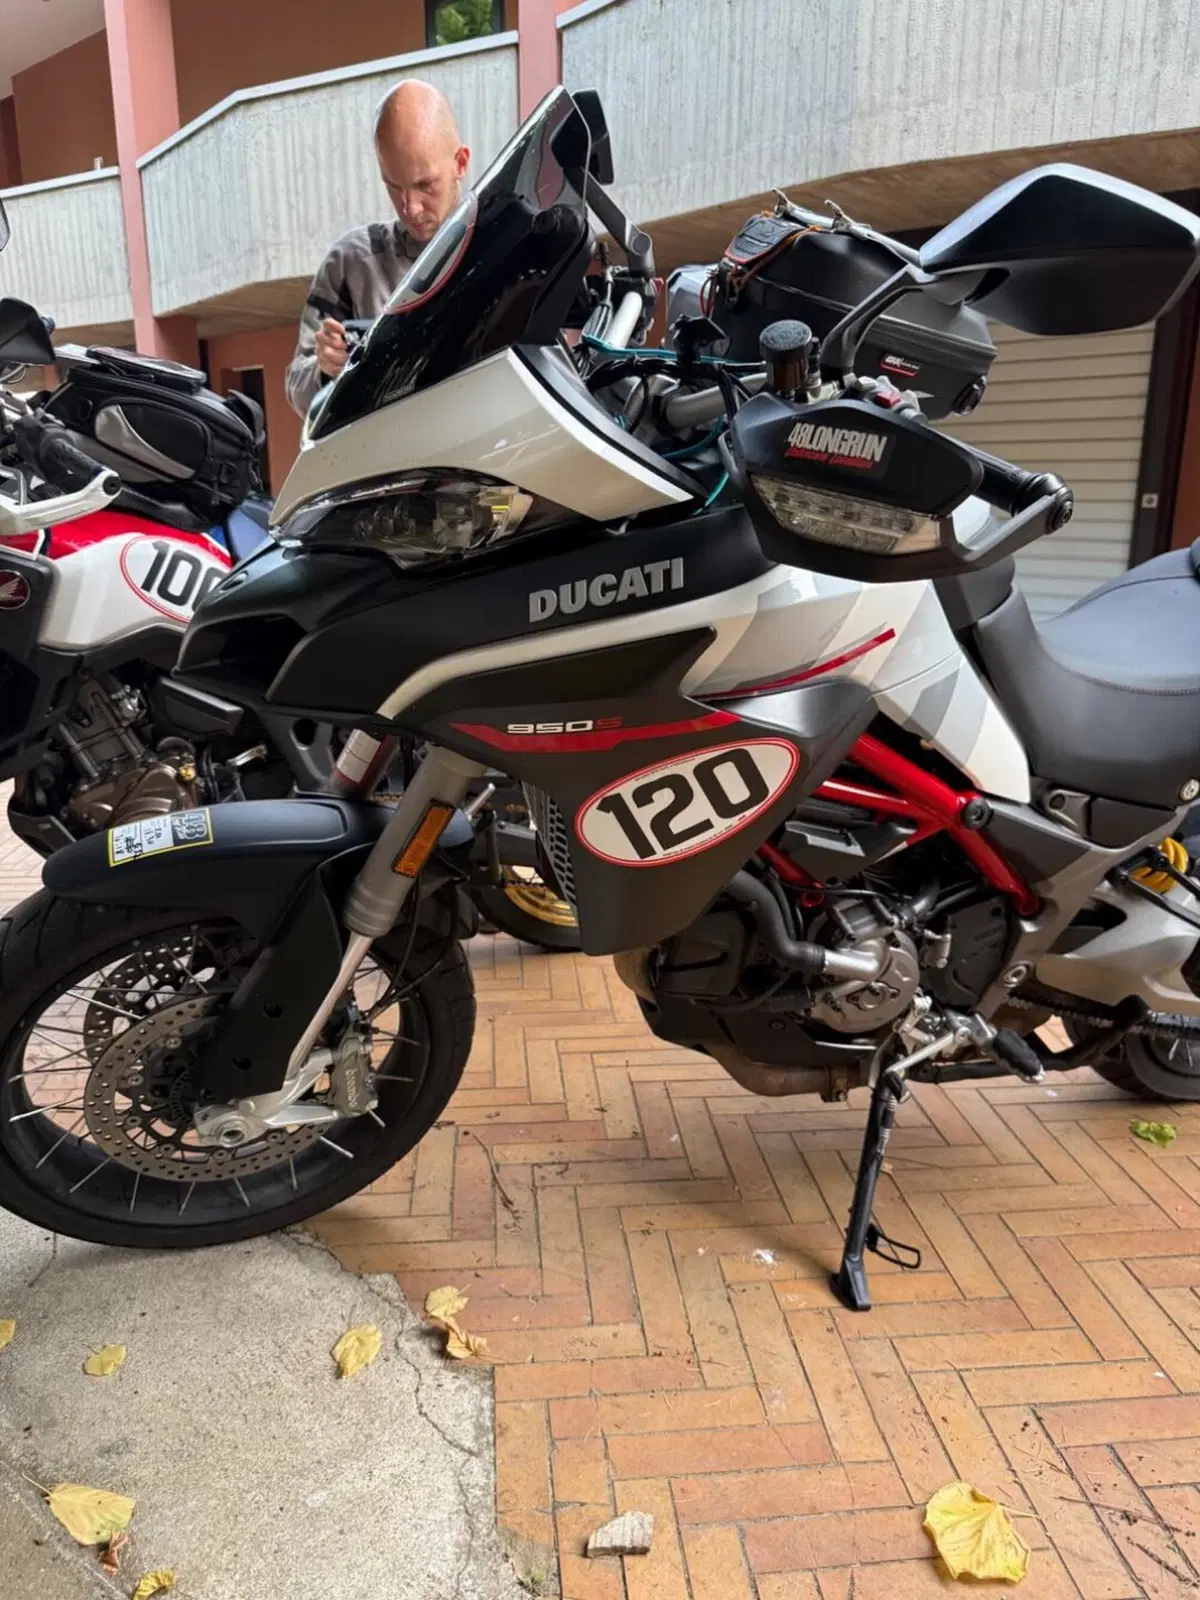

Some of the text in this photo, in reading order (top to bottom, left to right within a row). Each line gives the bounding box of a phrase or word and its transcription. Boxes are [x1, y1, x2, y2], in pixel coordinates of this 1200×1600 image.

[787, 422, 888, 462] 48LONGRUN
[528, 557, 684, 623] DUCATI
[596, 748, 770, 860] 120
[345, 1068, 360, 1108] brembo
